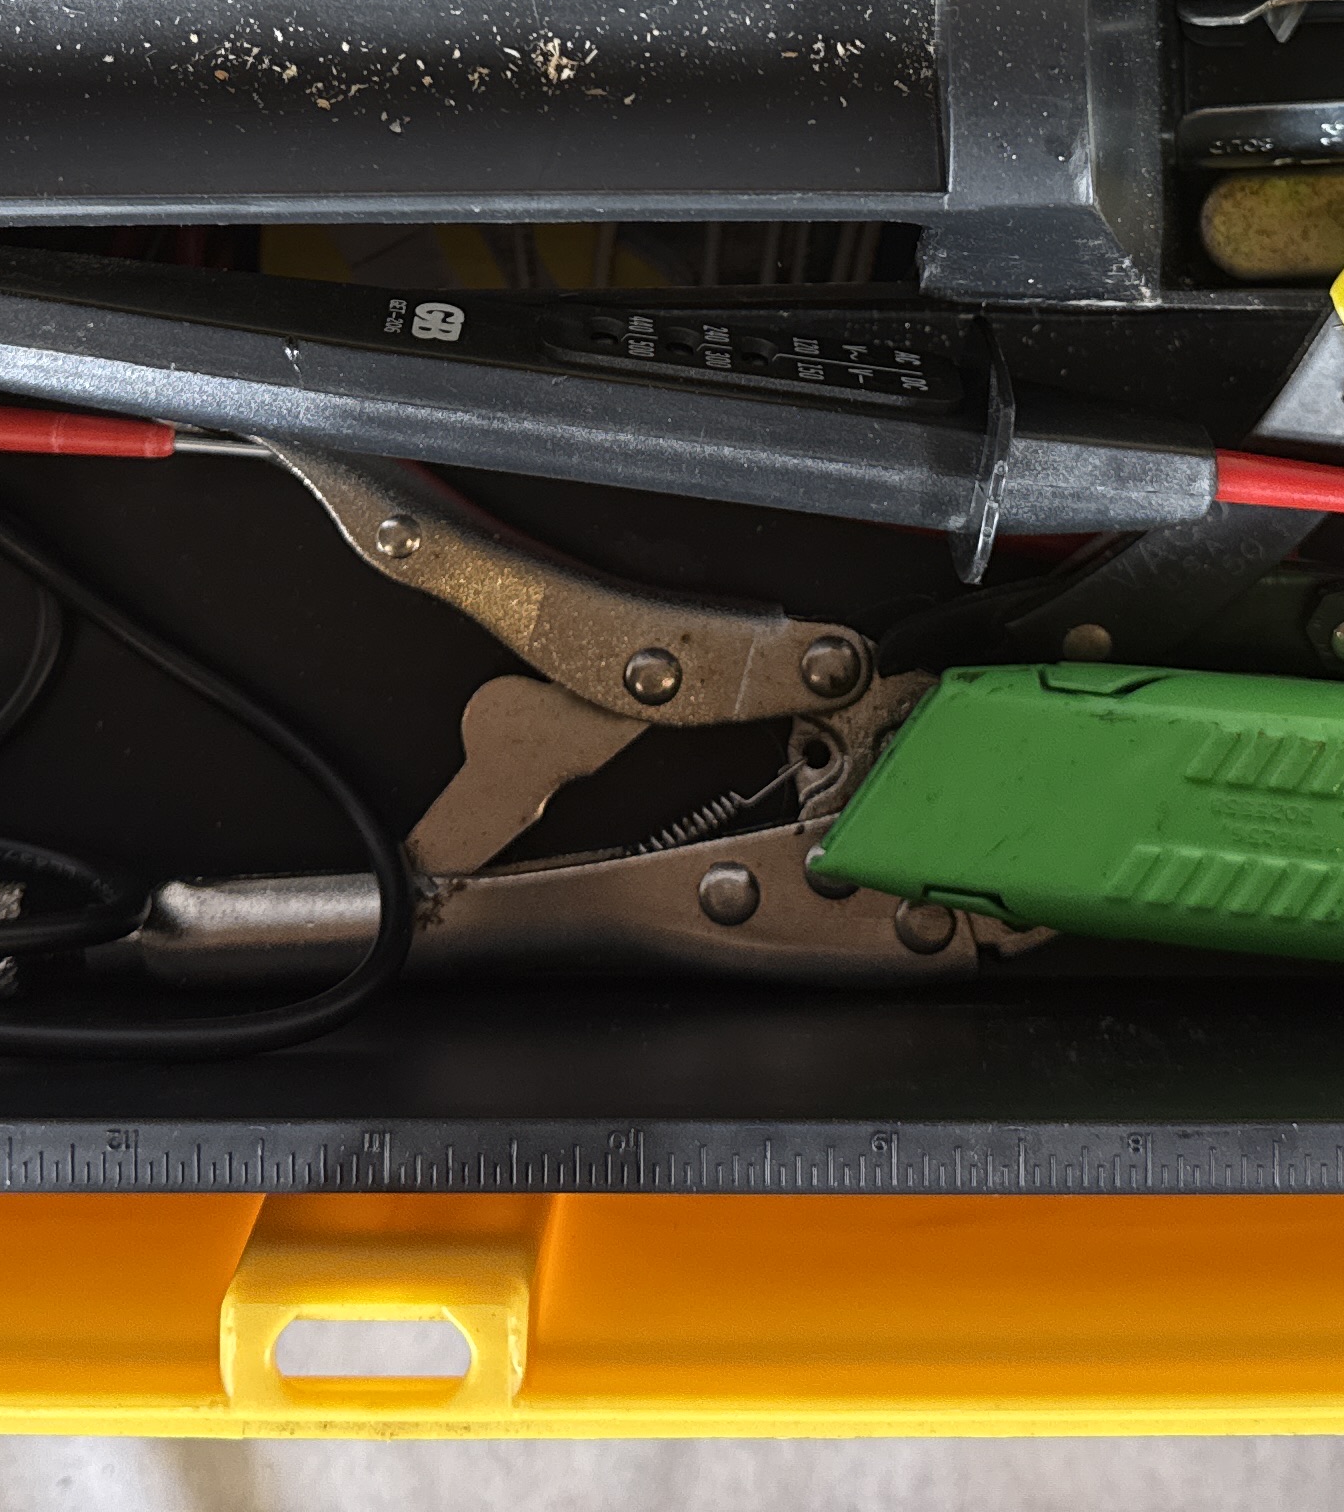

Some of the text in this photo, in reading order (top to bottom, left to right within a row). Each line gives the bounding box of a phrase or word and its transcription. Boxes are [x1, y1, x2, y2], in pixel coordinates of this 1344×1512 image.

[382, 298, 406, 333] GET-206
[410, 302, 464, 341] GB
[626, 315, 654, 357] 440 500
[701, 324, 731, 369] 240 300
[791, 336, 824, 381] 120 150
[893, 349, 928, 391] AC DC
